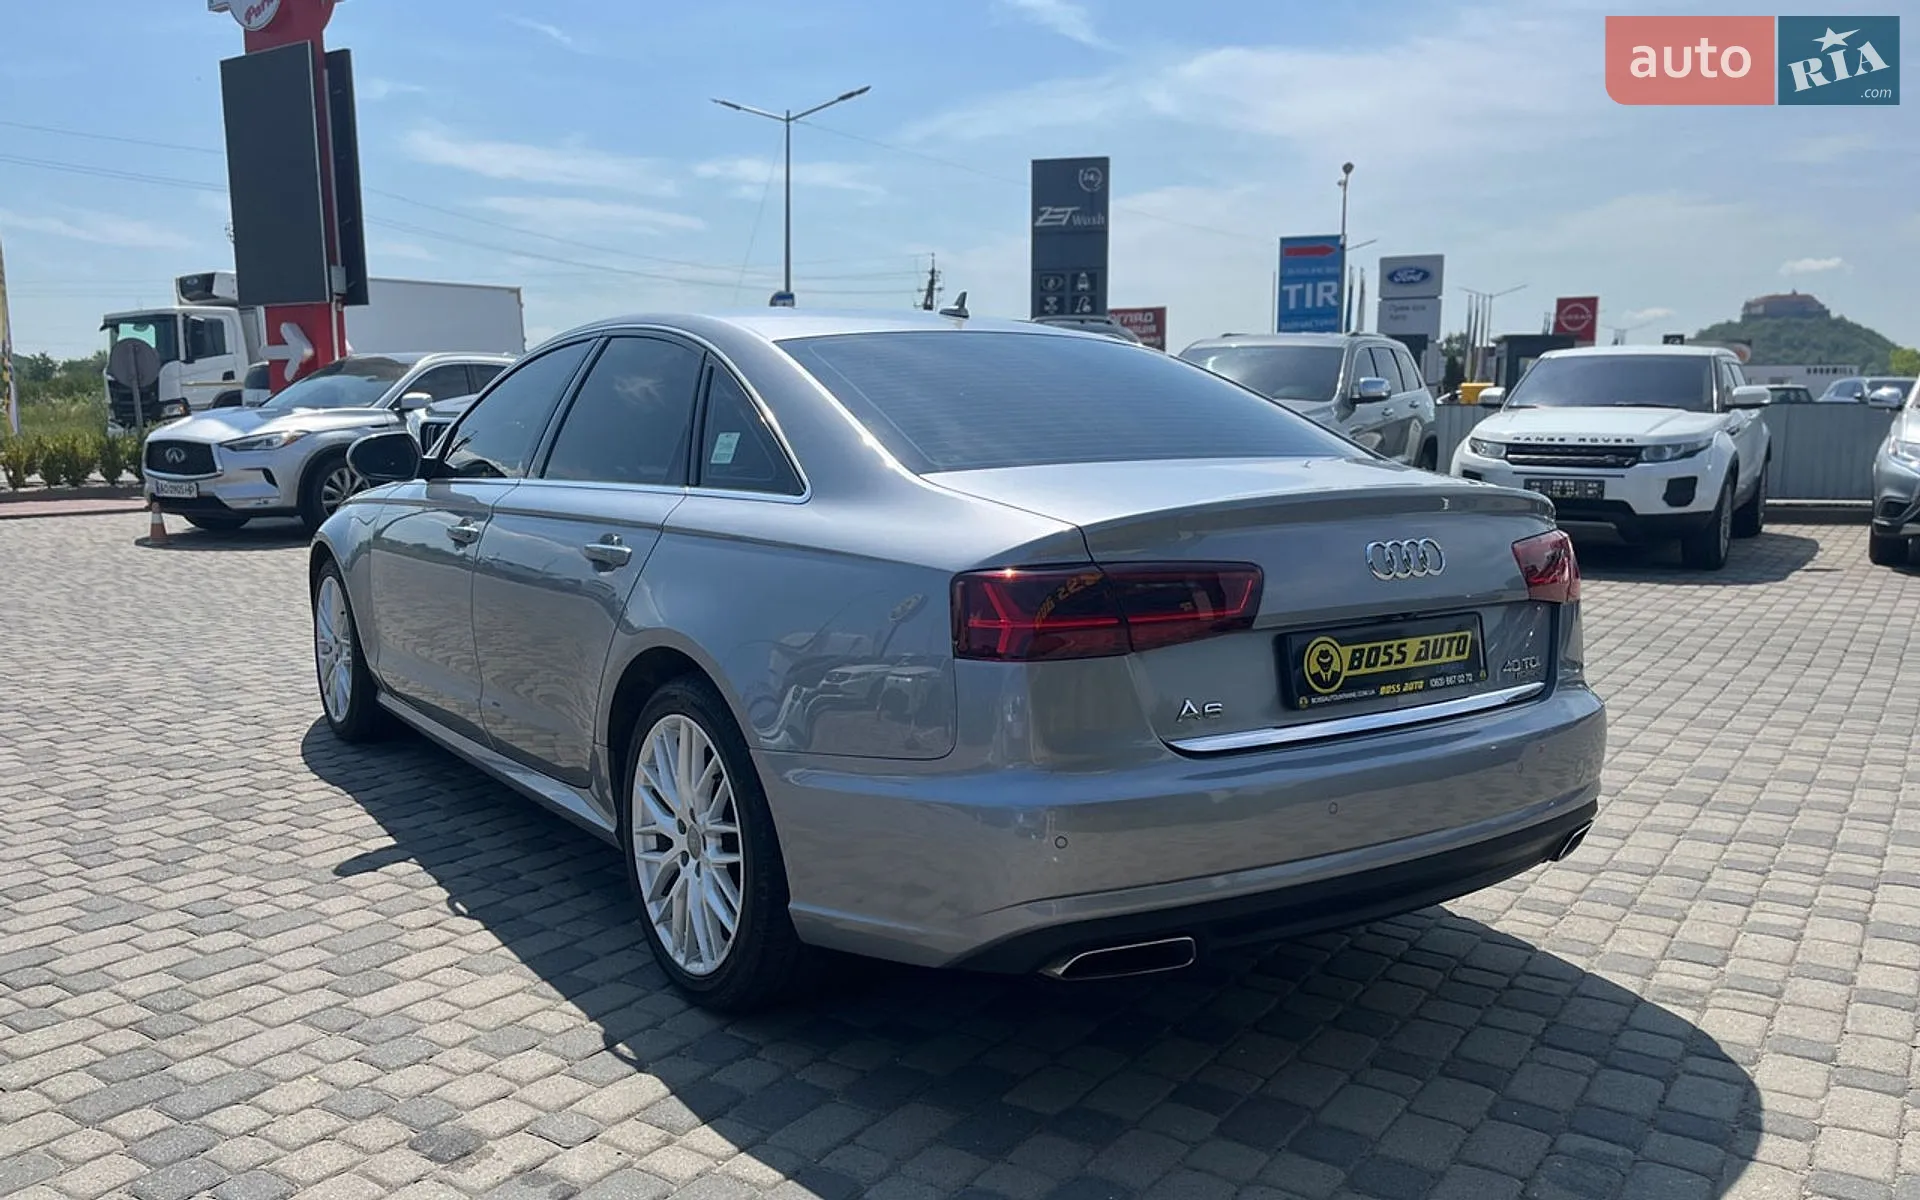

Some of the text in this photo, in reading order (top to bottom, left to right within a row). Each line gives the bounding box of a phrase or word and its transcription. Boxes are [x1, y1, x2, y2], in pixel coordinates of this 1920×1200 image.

[1034, 206, 1080, 226] ZET
[1282, 281, 1340, 309] TIR
[1347, 634, 1469, 671] BOSS AUTO
[1176, 699, 1223, 721] A6
